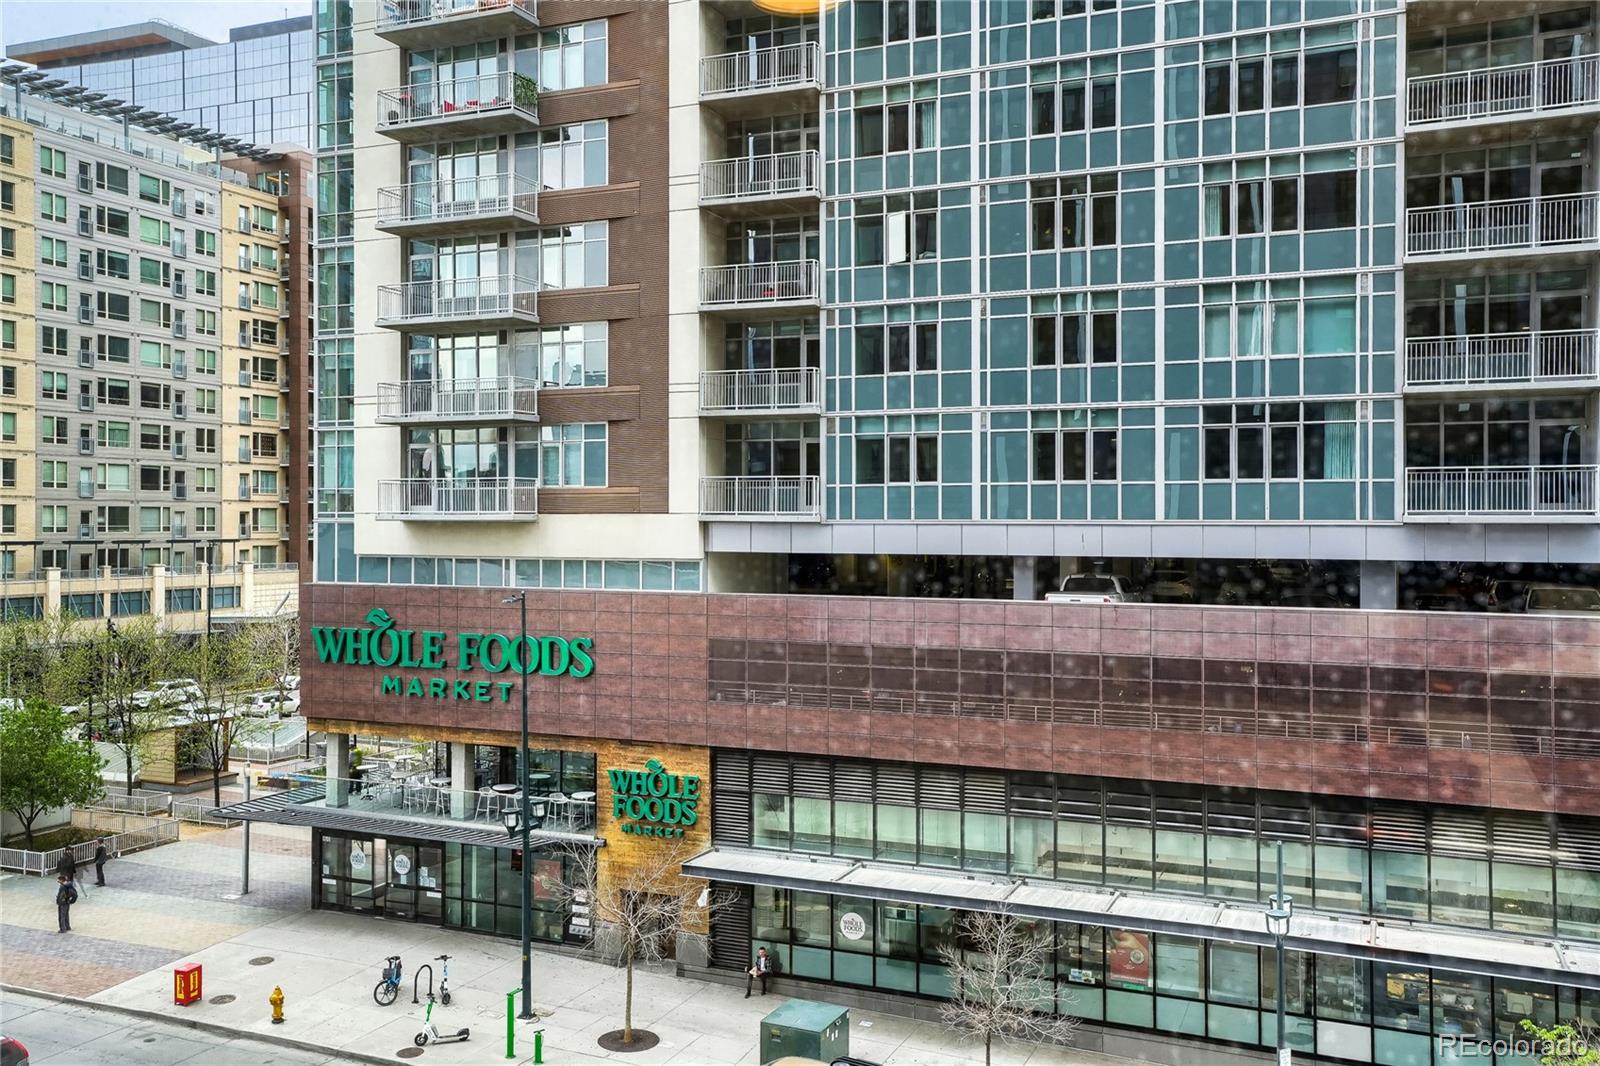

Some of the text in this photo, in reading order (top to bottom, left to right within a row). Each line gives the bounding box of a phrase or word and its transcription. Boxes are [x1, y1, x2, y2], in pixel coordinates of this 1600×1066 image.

[310, 608, 595, 679] WHOLE FOODS
[381, 674, 513, 703] MARKET
[607, 758, 700, 800] WHOLE
[611, 794, 697, 826] FOODS
[620, 823, 685, 839] MARKET
